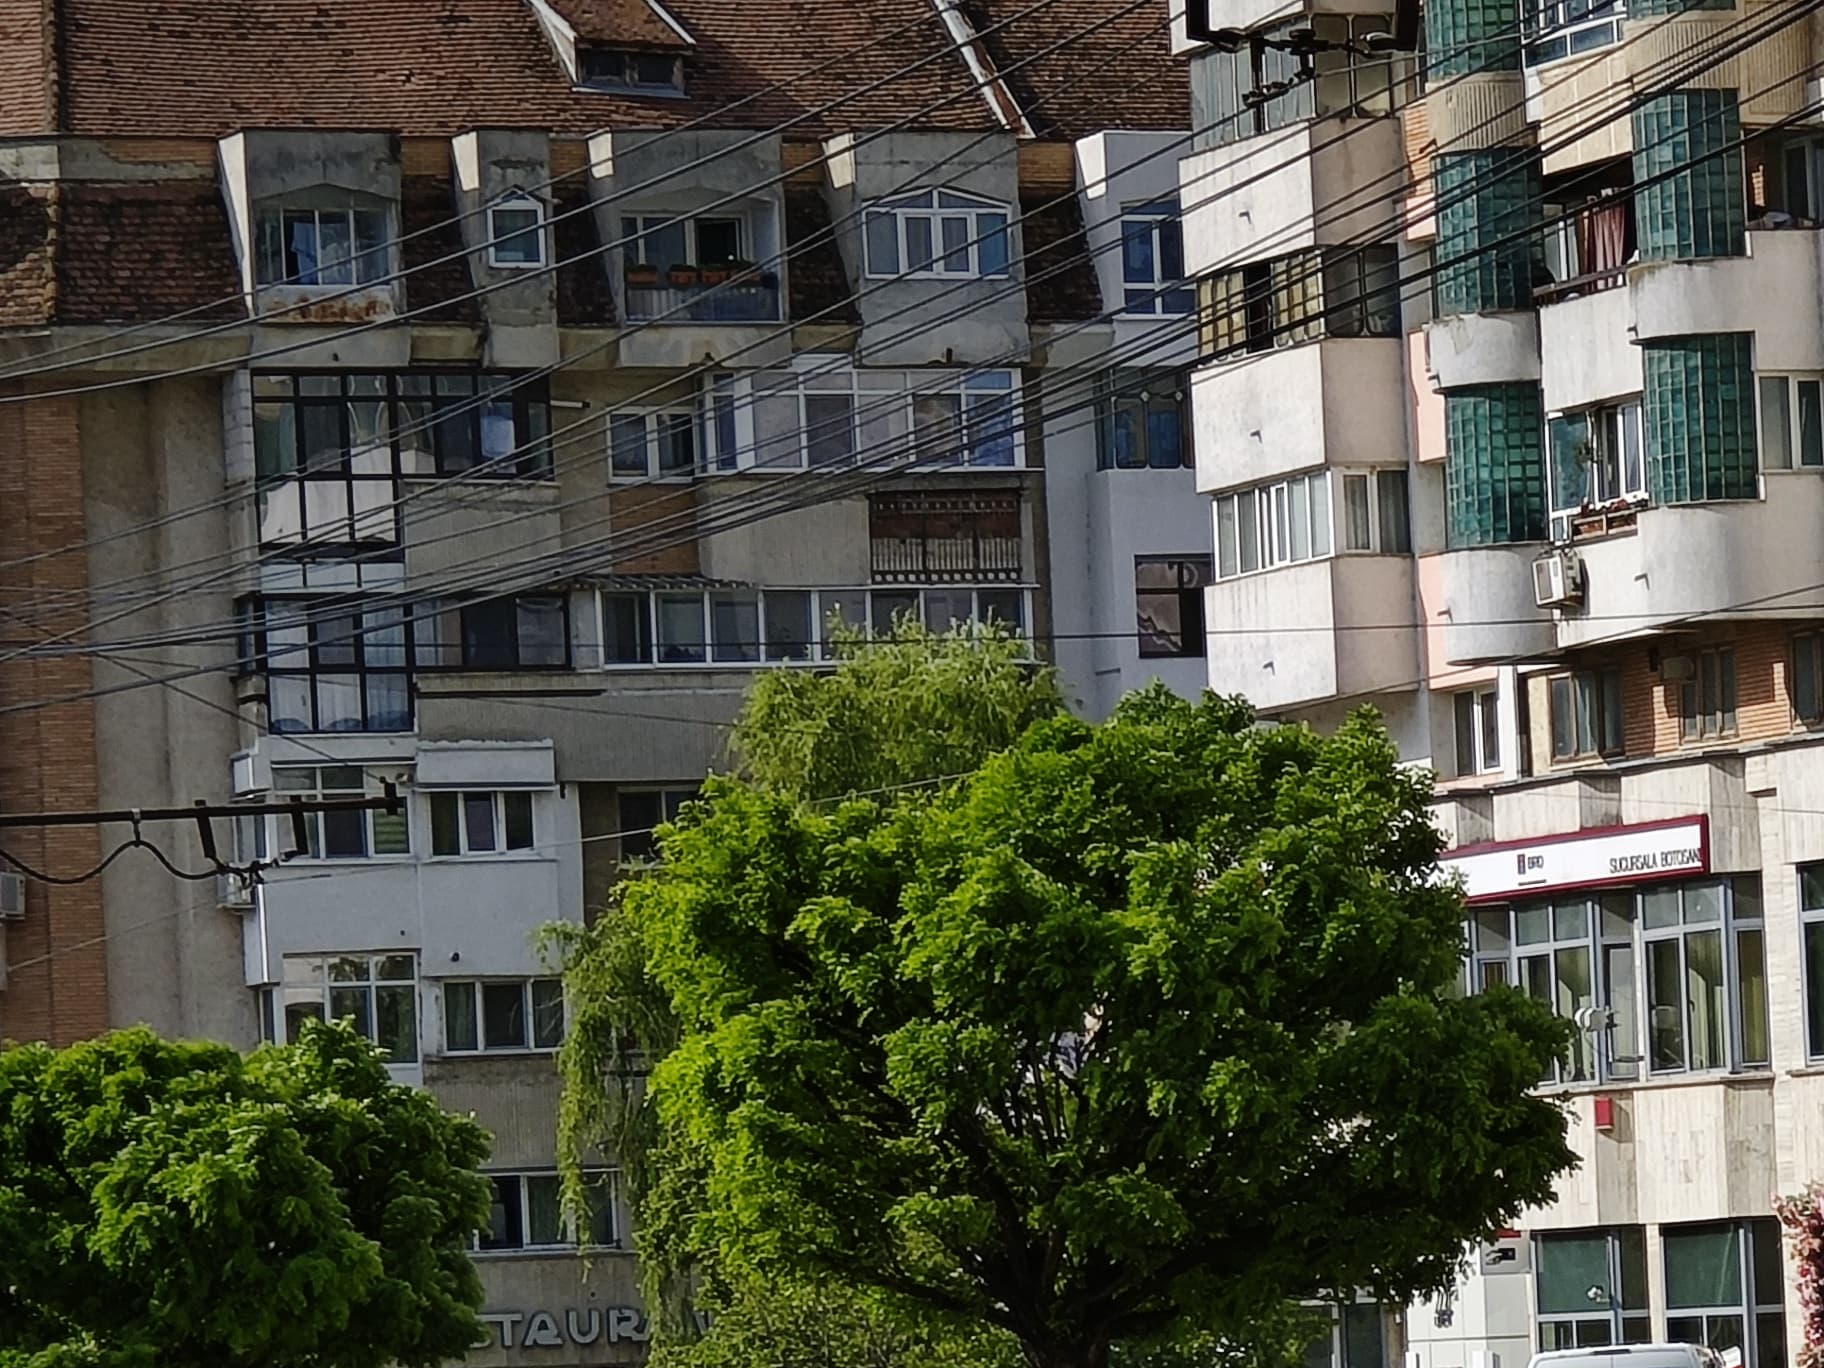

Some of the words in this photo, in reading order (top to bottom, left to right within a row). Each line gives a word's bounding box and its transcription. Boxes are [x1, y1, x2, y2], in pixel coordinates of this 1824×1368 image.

[1609, 853, 1658, 874] SUCURSALA
[1660, 848, 1702, 868] BOTOSAN
[468, 1307, 651, 1350] TAUR
